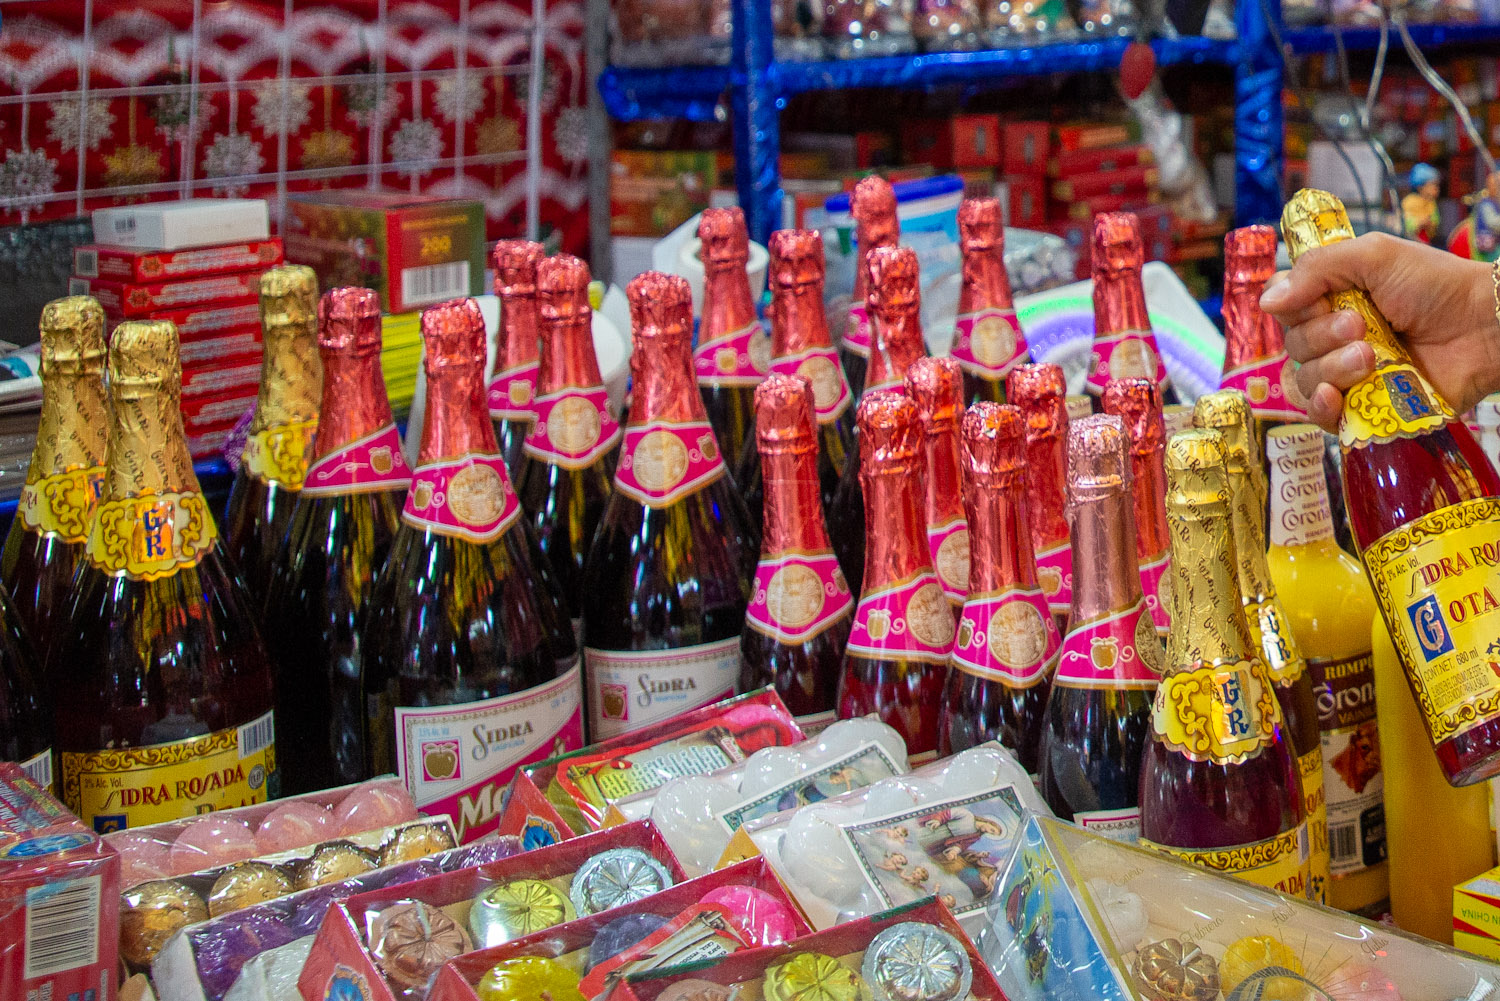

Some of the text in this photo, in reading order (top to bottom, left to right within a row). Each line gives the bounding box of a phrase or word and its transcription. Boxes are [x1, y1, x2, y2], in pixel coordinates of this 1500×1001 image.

[472, 720, 534, 761] SIDRA
[175, 763, 247, 800] ROSADA
[1461, 908, 1489, 922] CHINA
[1490, 913, 1500, 926] IN
